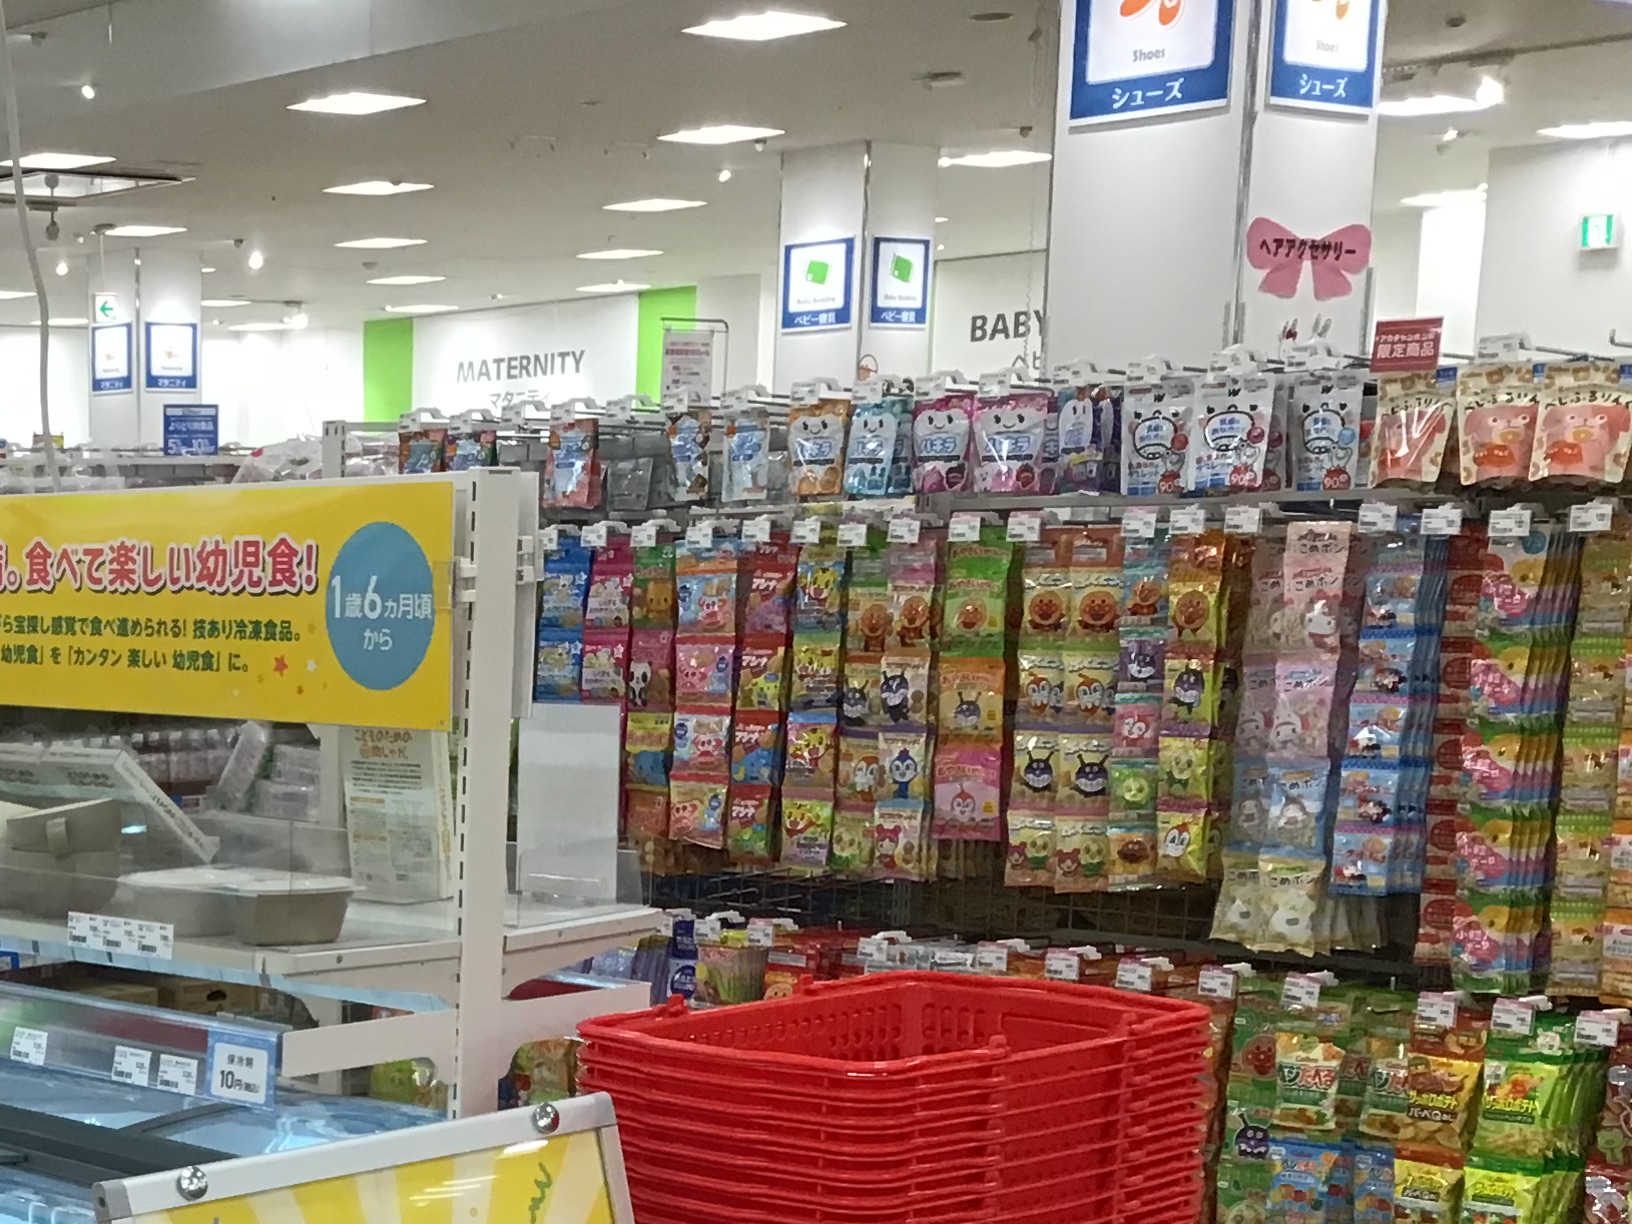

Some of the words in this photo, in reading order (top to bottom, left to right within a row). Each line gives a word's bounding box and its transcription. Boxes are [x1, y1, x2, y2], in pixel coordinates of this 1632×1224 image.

[1132, 48, 1165, 63] Shoes
[1111, 77, 1185, 110] シューズ
[1299, 73, 1349, 98] シューズ
[1259, 238, 1357, 261] ヘアアクセサリー
[1376, 342, 1435, 359] 限定商品
[457, 350, 586, 383] MATERNITY
[363, 628, 394, 651] から
